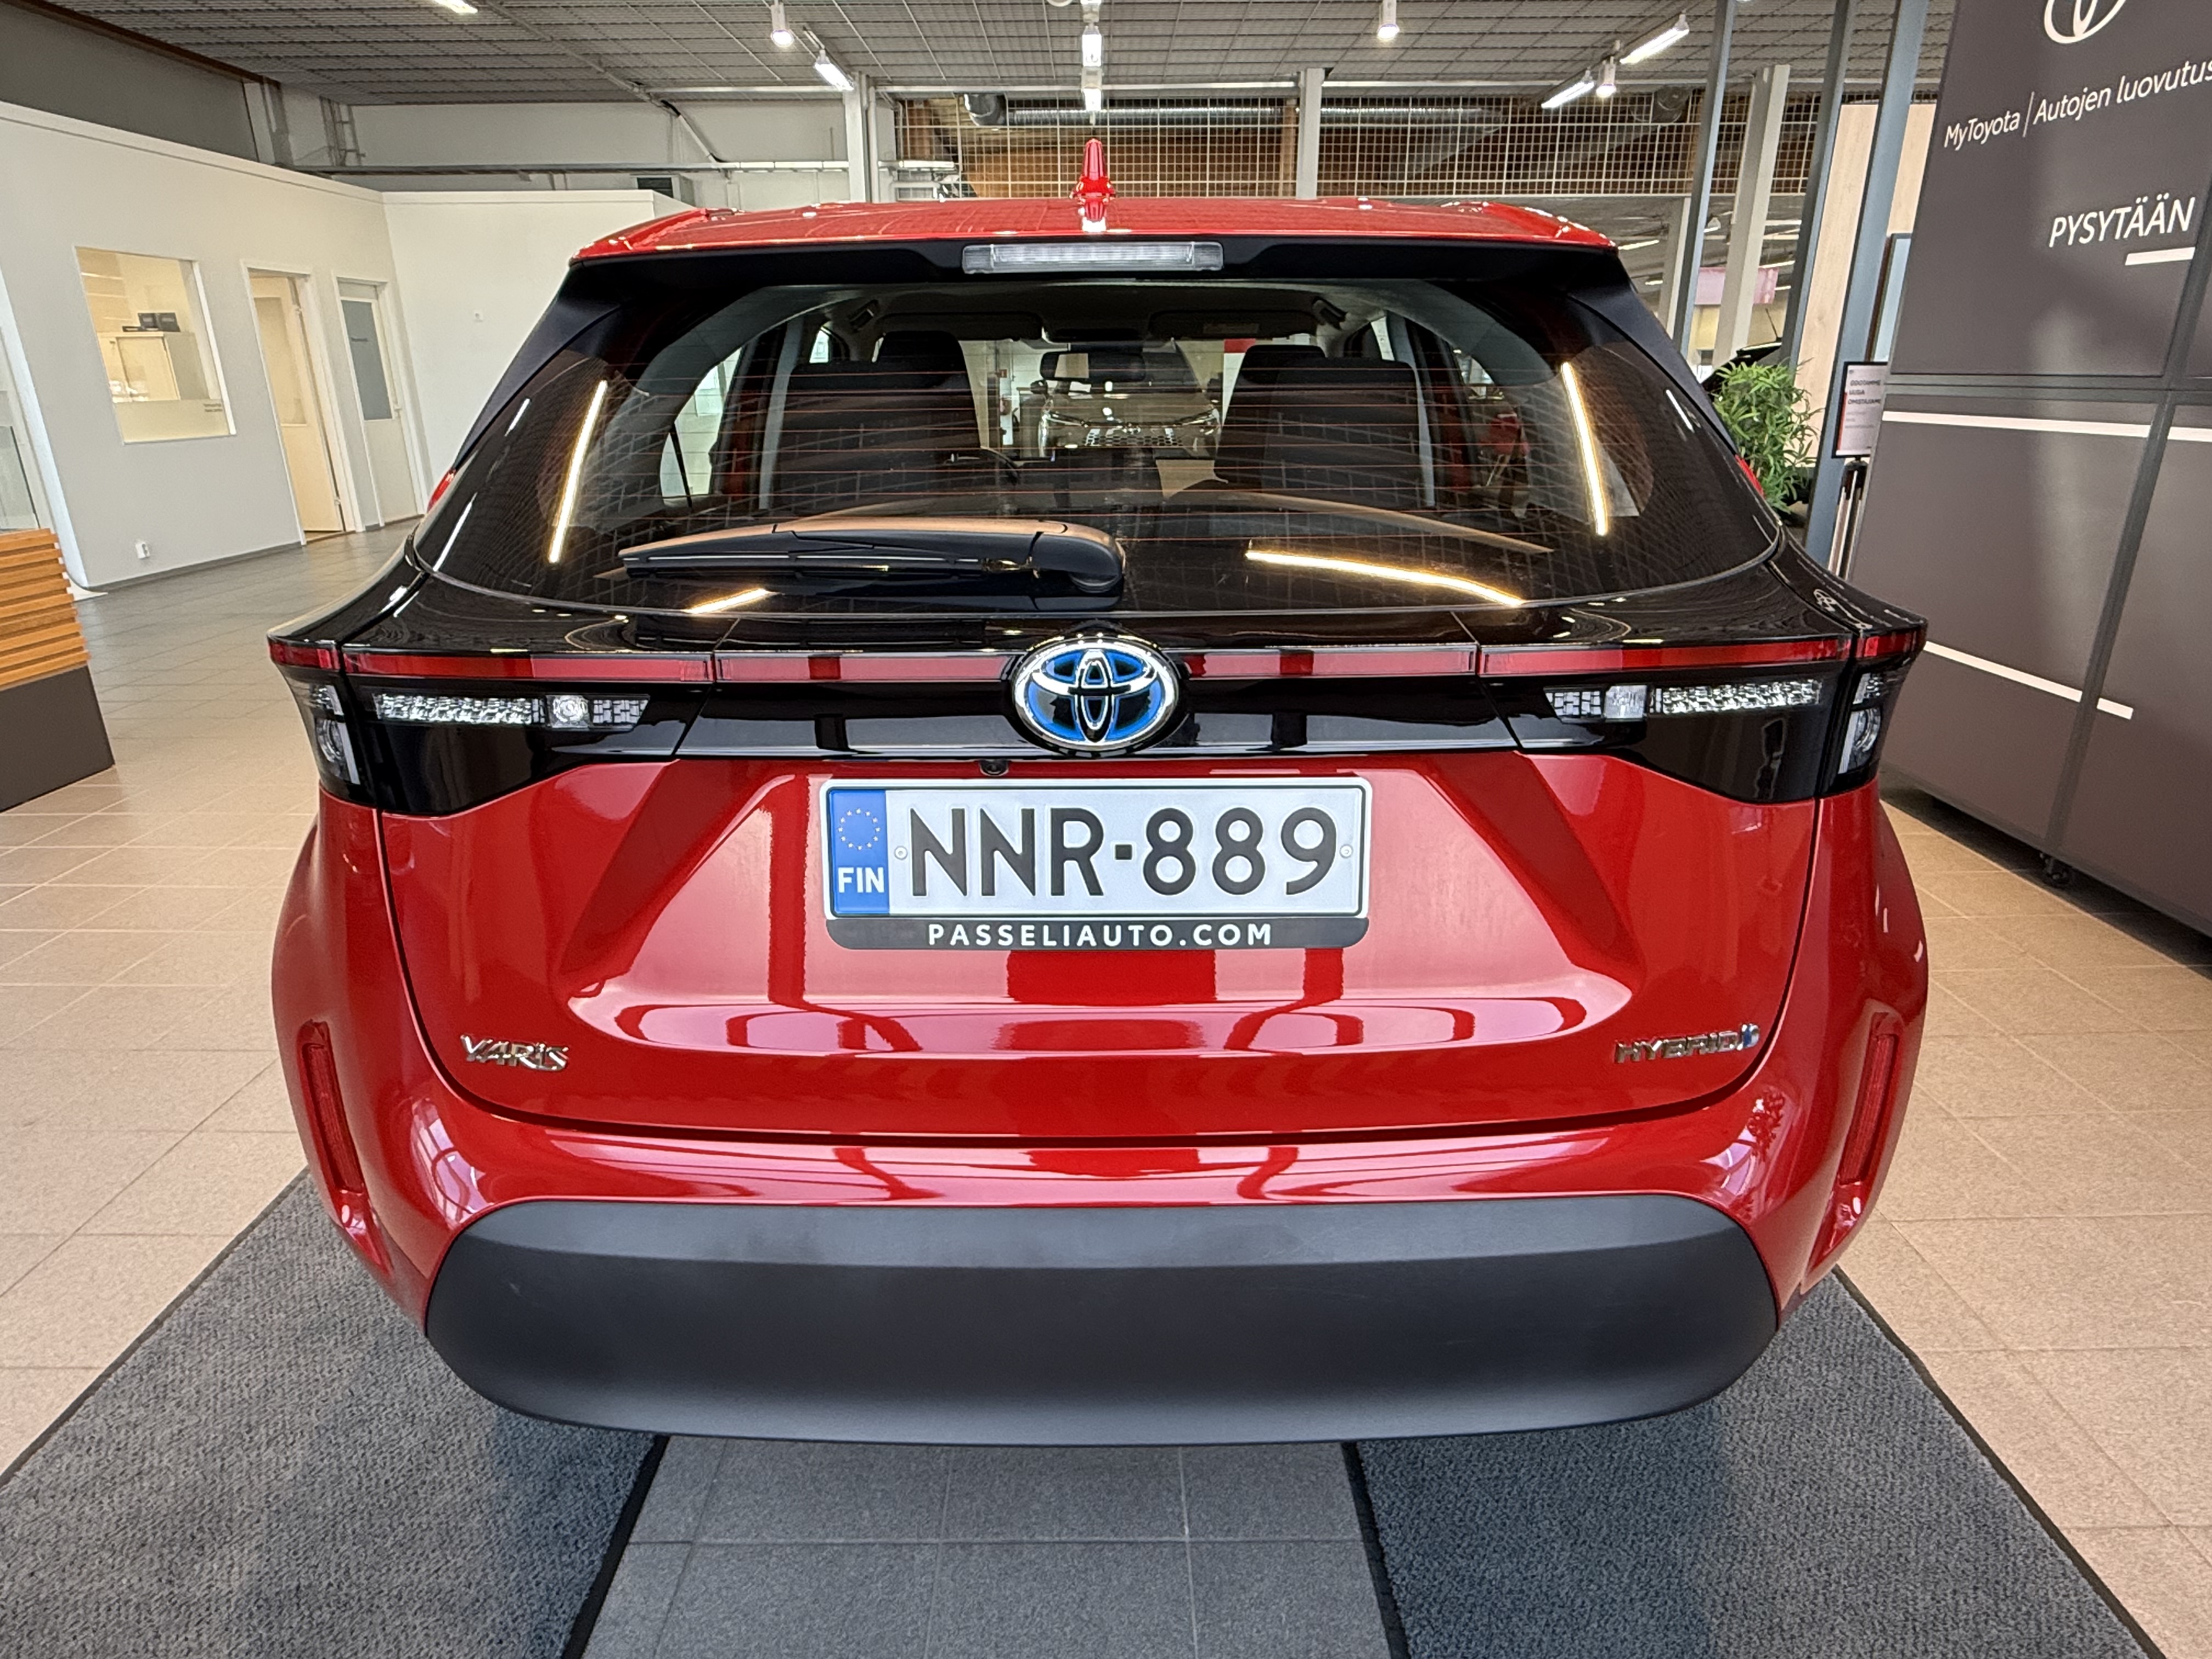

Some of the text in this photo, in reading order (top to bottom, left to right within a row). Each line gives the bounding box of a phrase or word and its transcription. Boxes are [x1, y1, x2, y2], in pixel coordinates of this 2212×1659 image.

[1944, 110, 2021, 151] MyToyota
[2032, 87, 2112, 125] Autojen
[2049, 193, 2195, 247] PYSYTÄÄN
[910, 807, 1336, 896] NNR-889
[838, 867, 884, 893] FIN
[928, 923, 1271, 947] PASSELIAUTO.COM
[460, 1034, 569, 1071] YARIS
[1614, 1030, 1738, 1063] HYBRID
